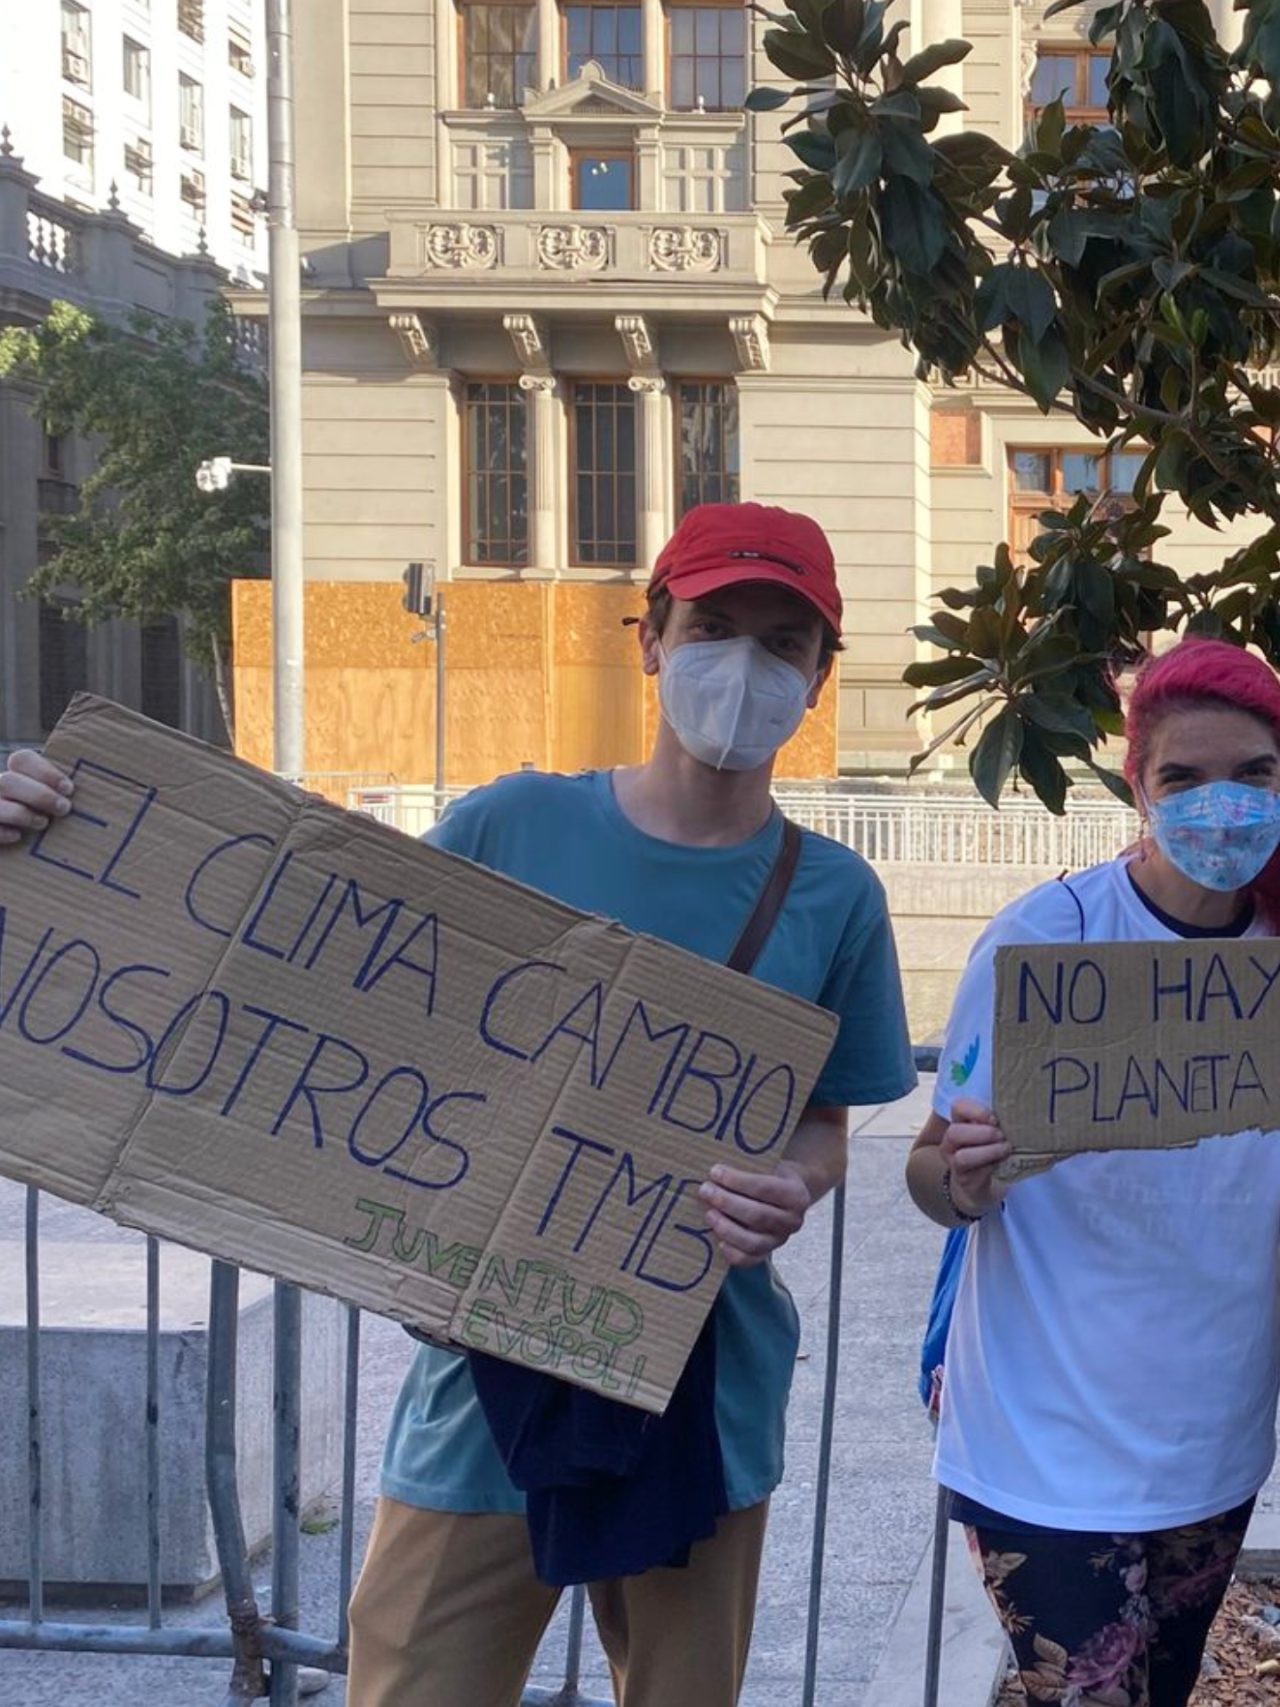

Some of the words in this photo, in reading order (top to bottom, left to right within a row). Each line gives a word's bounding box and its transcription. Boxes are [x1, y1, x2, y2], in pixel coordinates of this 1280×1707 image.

[30, 758, 158, 900] EL
[184, 832, 440, 1018] CLIMA
[480, 960, 796, 1157] CAMBIO
[1018, 958, 1106, 1024] NO
[1041, 1050, 1269, 1124] PLANETA
[342, 1197, 645, 1347] JUVENTUD
[549, 1125, 715, 1294] TMB
